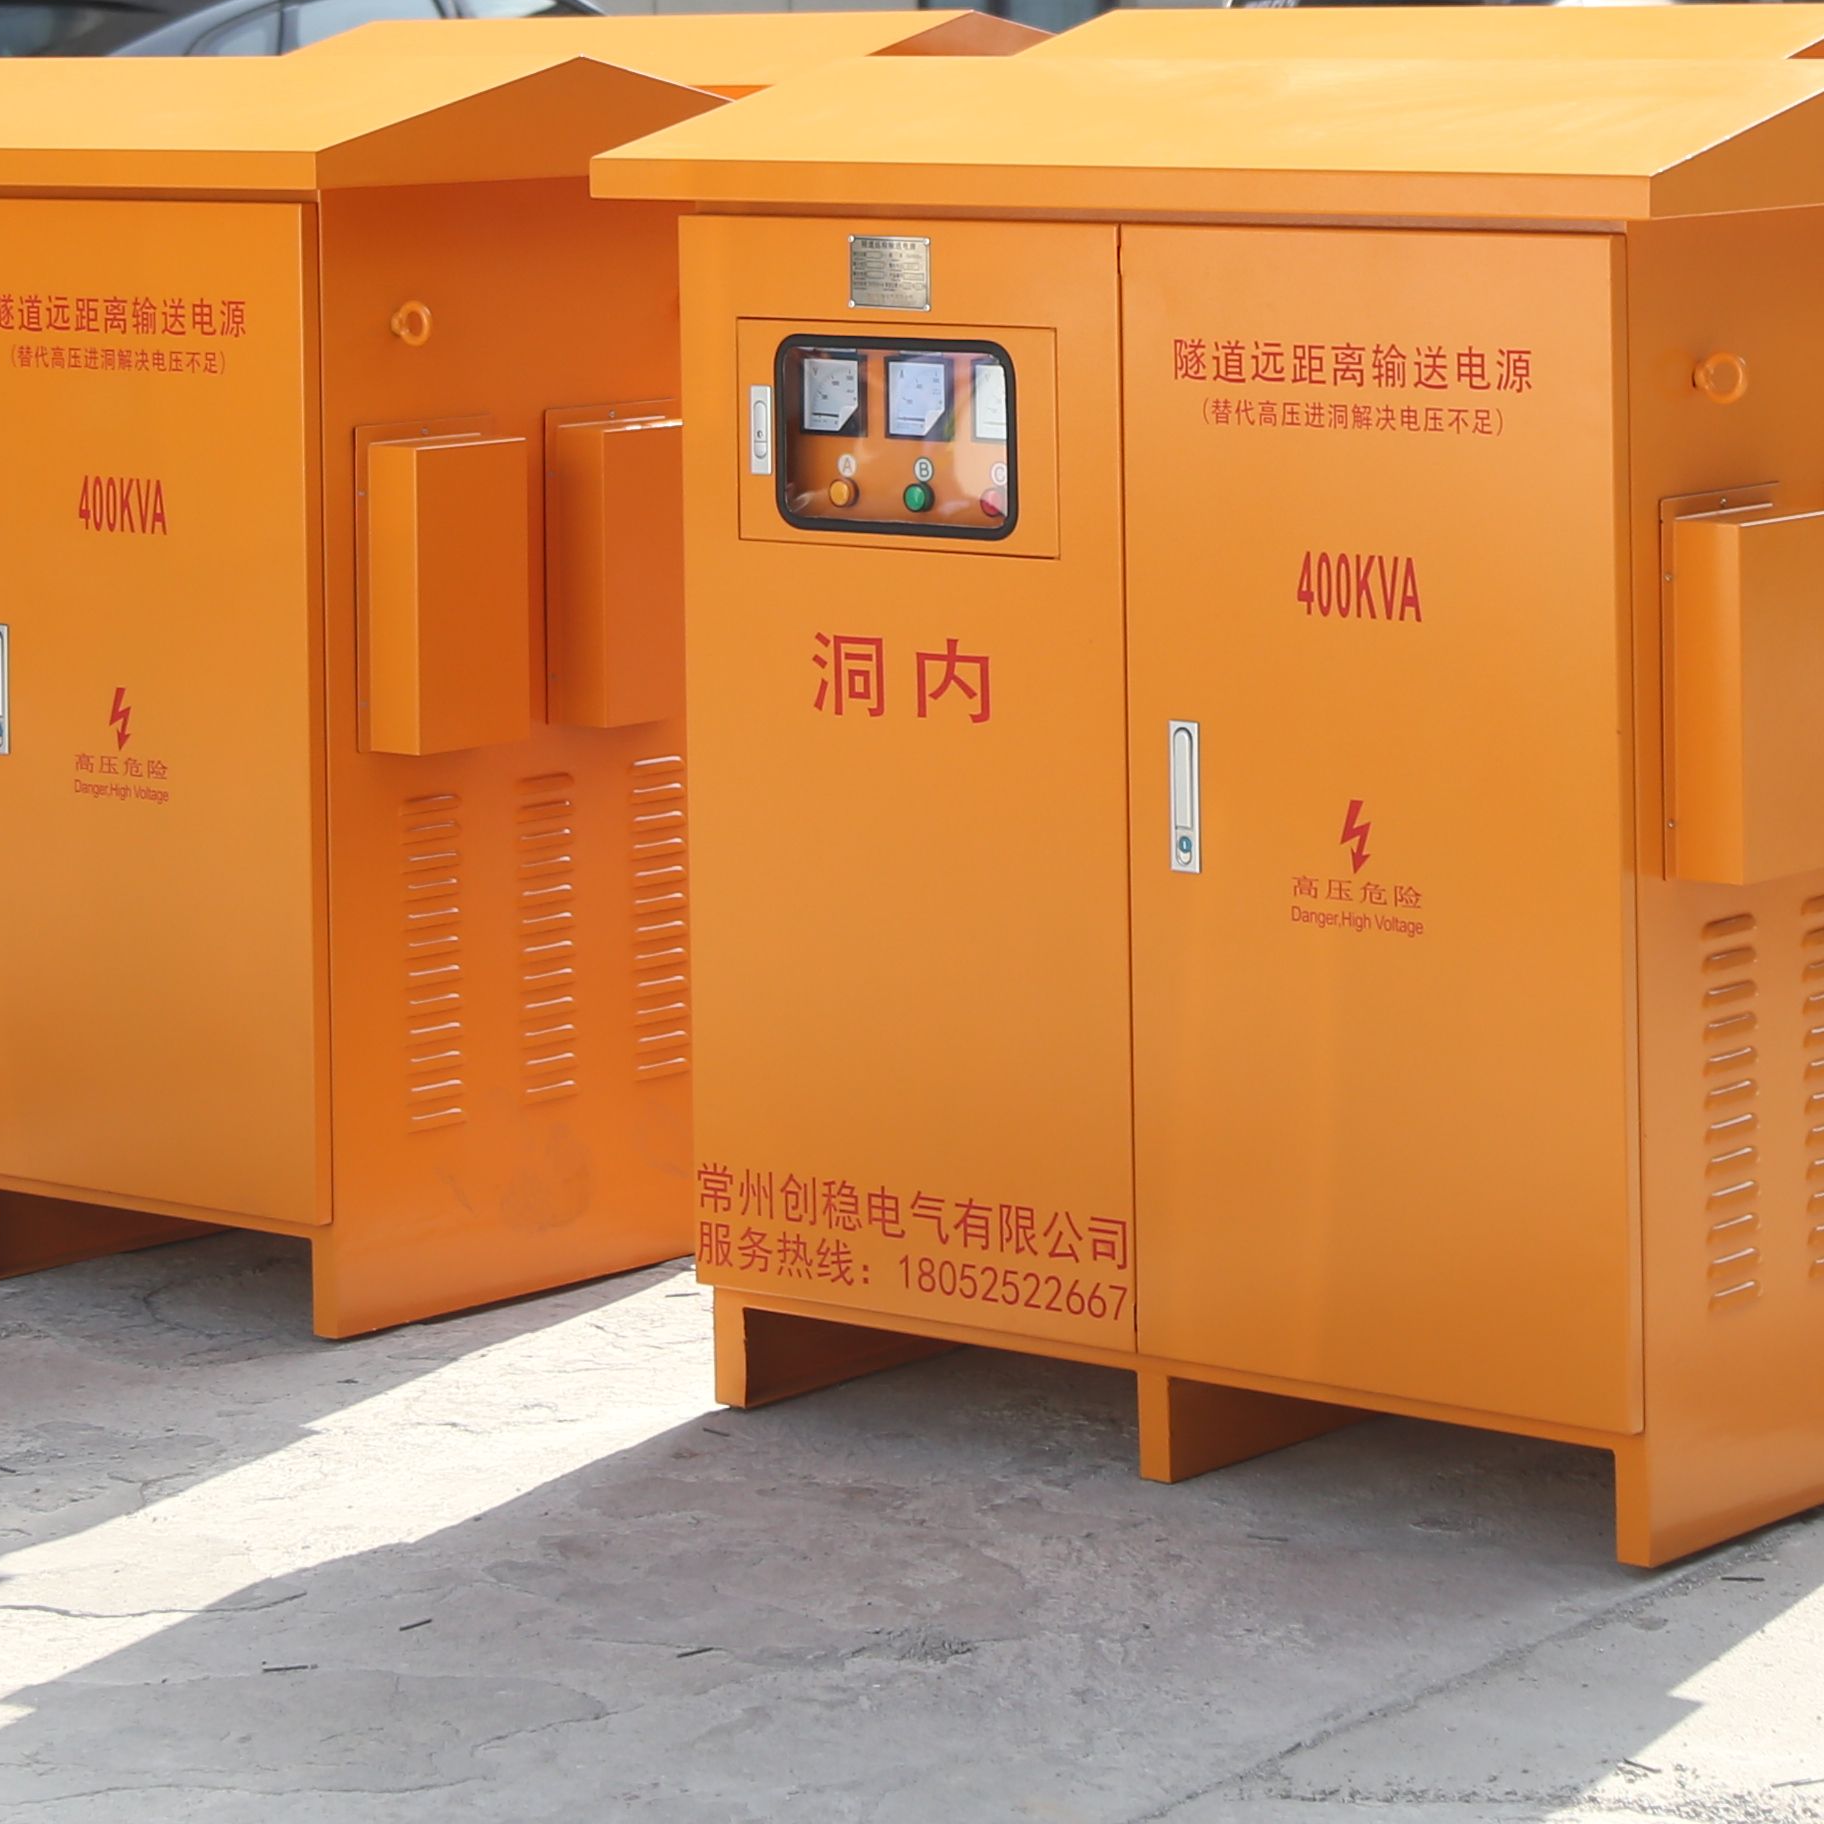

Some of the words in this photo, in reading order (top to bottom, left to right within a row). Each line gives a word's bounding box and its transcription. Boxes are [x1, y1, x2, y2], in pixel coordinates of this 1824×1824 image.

[1173, 338, 1532, 394] 隧道远距离输送电源
[1202, 398, 1503, 437] （替代高压进洞解决电压不足）
[78, 474, 168, 536] 400KVA
[1296, 550, 1423, 623] 400KVA
[811, 631, 991, 724] 洞内
[74, 753, 168, 780] 高压危险
[134, 785, 169, 805] Voltage
[1291, 875, 1422, 909] 高压危险
[1374, 914, 1424, 938] Voltage
[697, 1162, 1128, 1271] 常州创稳电气有限公司
[898, 1254, 1128, 1322] 18052522667
